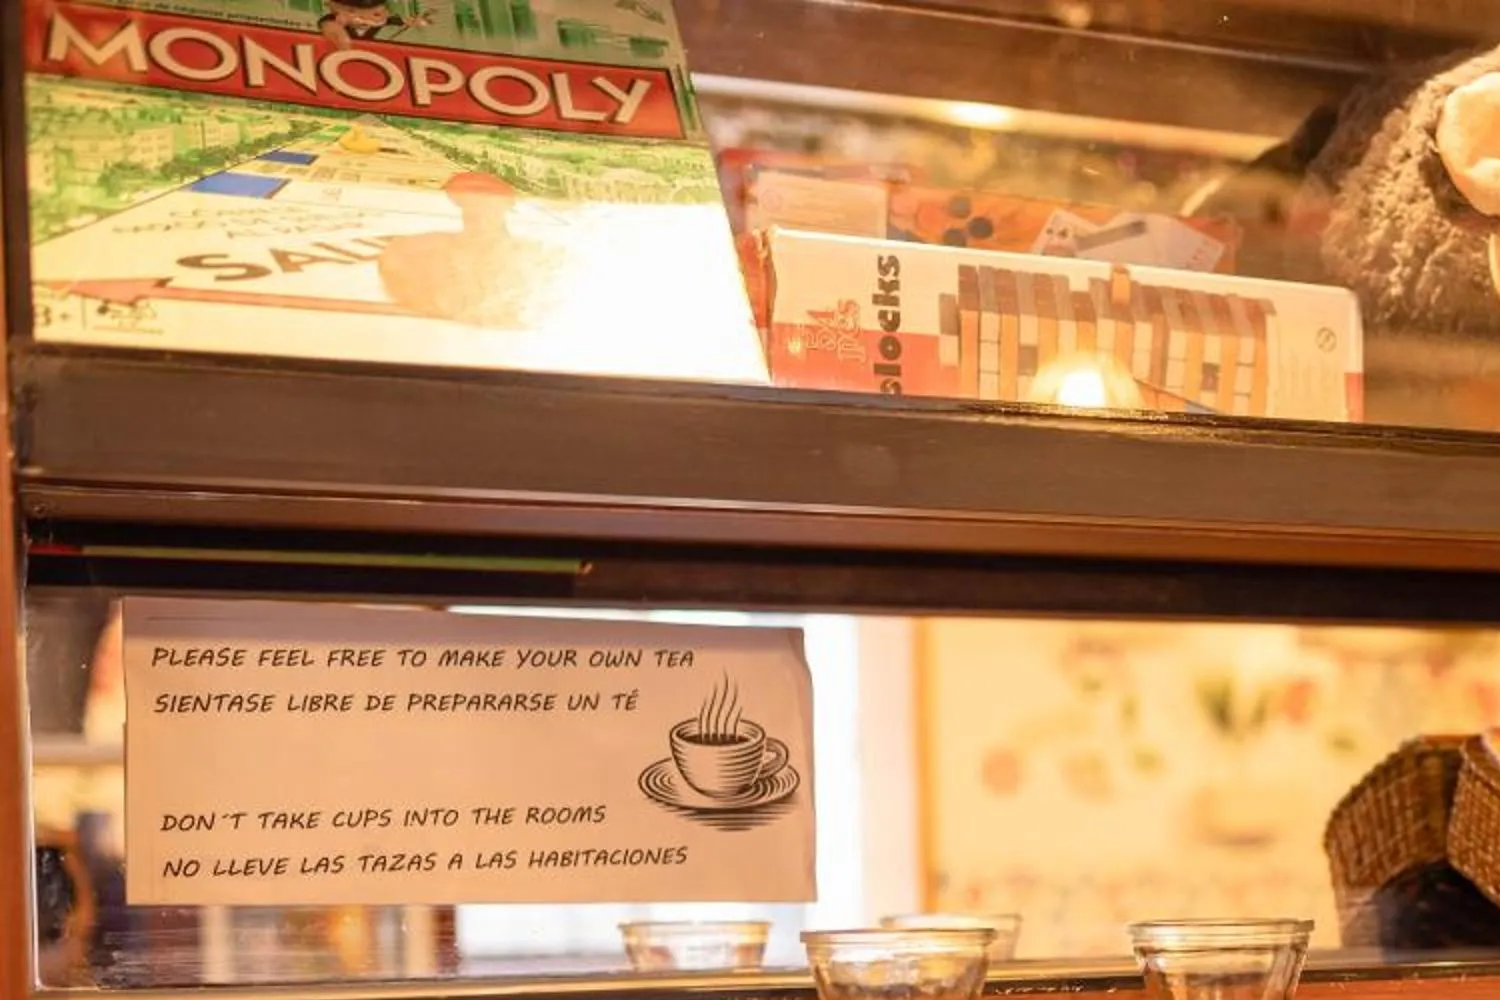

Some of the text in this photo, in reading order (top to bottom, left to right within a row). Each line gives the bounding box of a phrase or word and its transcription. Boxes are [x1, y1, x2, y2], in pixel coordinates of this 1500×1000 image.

[48, 13, 652, 125] MONOPOLY
[175, 233, 394, 282] SALI
[151, 647, 694, 669] PLEASE FEEL FREE TO MAKE YOUR OWN TEA
[153, 688, 639, 713] SIENTASE LIBRE DE PREPARARSE UN TÉ
[258, 811, 321, 830] TAKE
[332, 808, 393, 828] CUPS
[403, 807, 459, 827] INTO
[471, 806, 516, 825] THE
[525, 805, 606, 825] ROOMS
[163, 846, 688, 878] NO LLEVE LAS TAZAS A LAS HABITACIONES
